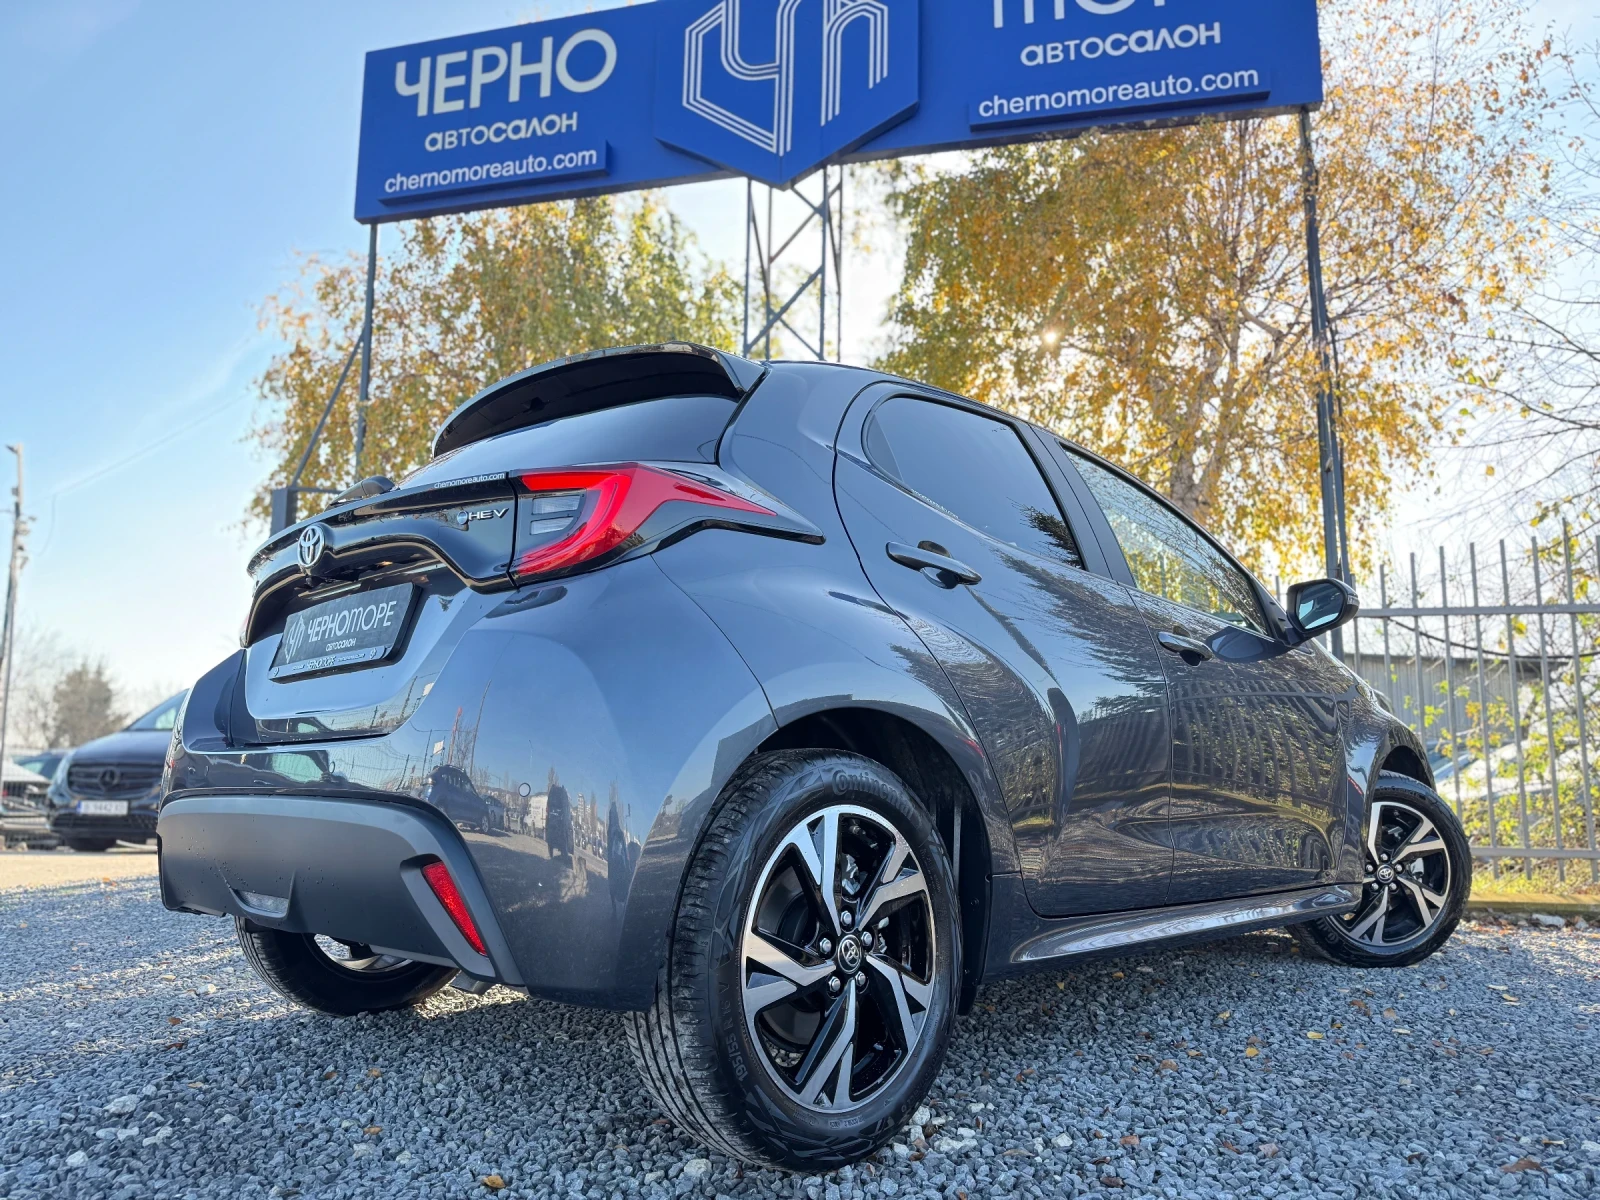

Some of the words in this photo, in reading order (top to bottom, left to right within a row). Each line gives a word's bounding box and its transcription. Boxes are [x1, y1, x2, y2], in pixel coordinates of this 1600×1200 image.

[394, 28, 618, 117] ЧЕРНО
[979, 69, 1259, 118] chernomoreauto.com
[384, 148, 598, 194] chernomoreauto.com
[469, 507, 509, 520] HEV
[727, 1033, 749, 1081] 195/55
